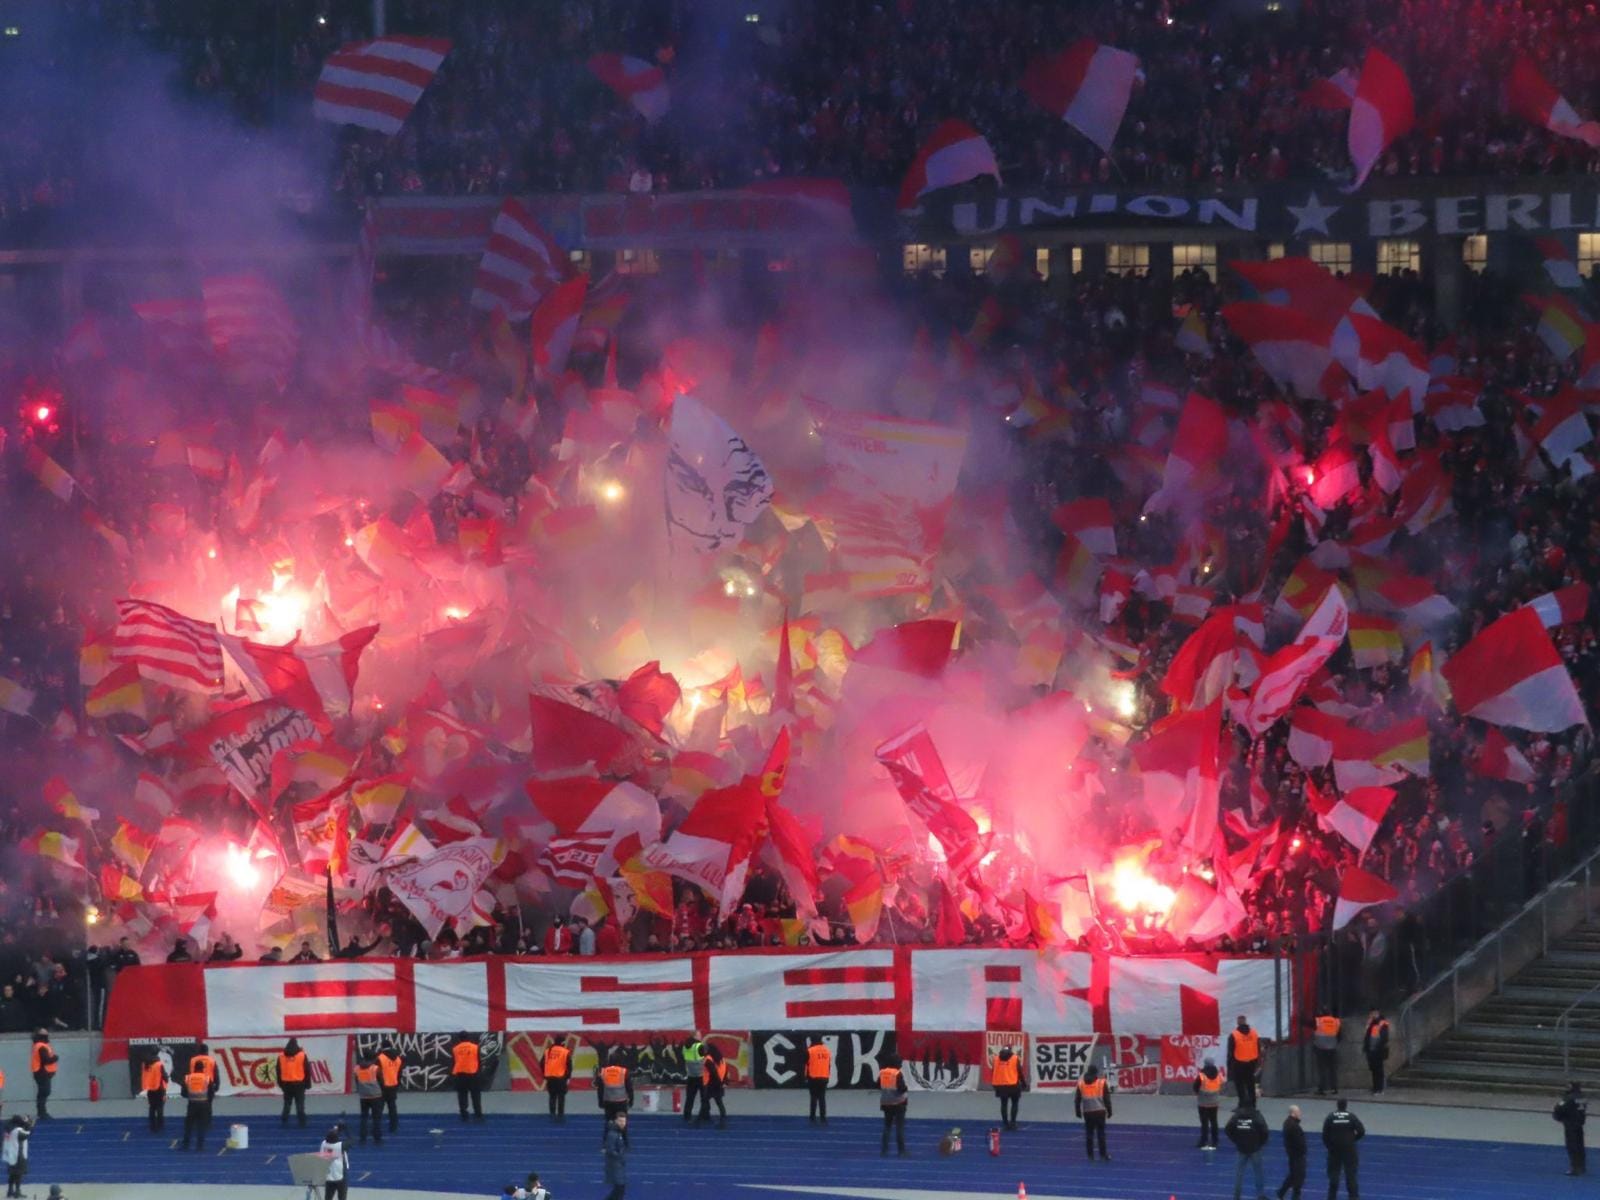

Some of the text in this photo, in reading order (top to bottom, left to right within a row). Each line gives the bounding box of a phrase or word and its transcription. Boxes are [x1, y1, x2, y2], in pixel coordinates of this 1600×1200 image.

[951, 193, 1600, 236] UNION BERL
[1036, 1043, 1091, 1064] SEK
